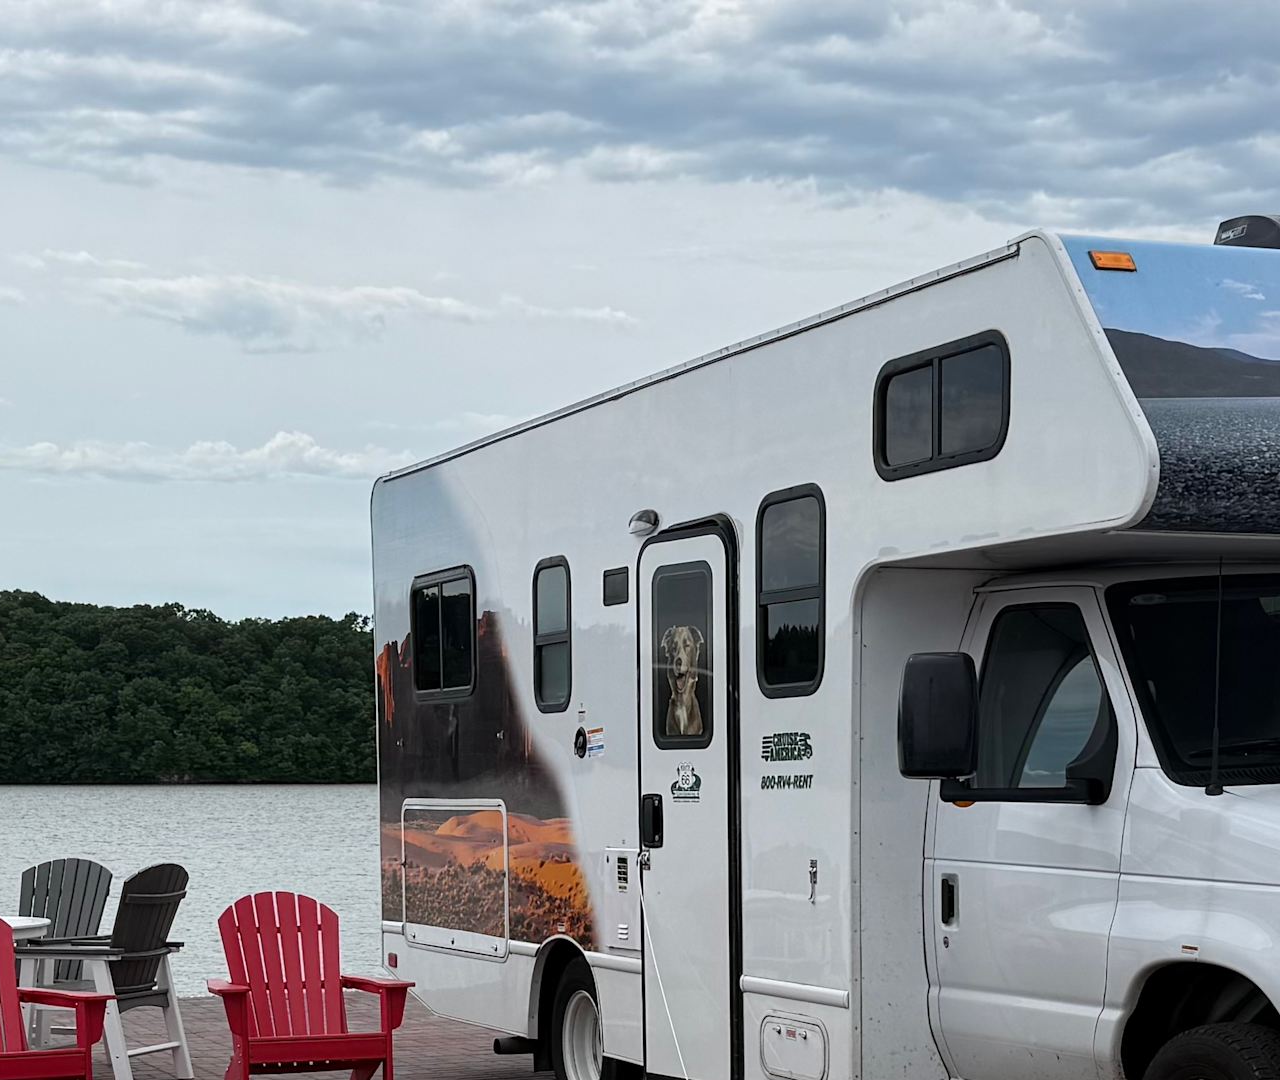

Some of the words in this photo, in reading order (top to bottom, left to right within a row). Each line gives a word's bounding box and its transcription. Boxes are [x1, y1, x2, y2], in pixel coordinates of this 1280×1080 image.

[772, 731, 799, 747] CRUISE
[769, 746, 804, 762] AMERICA
[760, 774, 814, 790] 800-RV4-RENT
